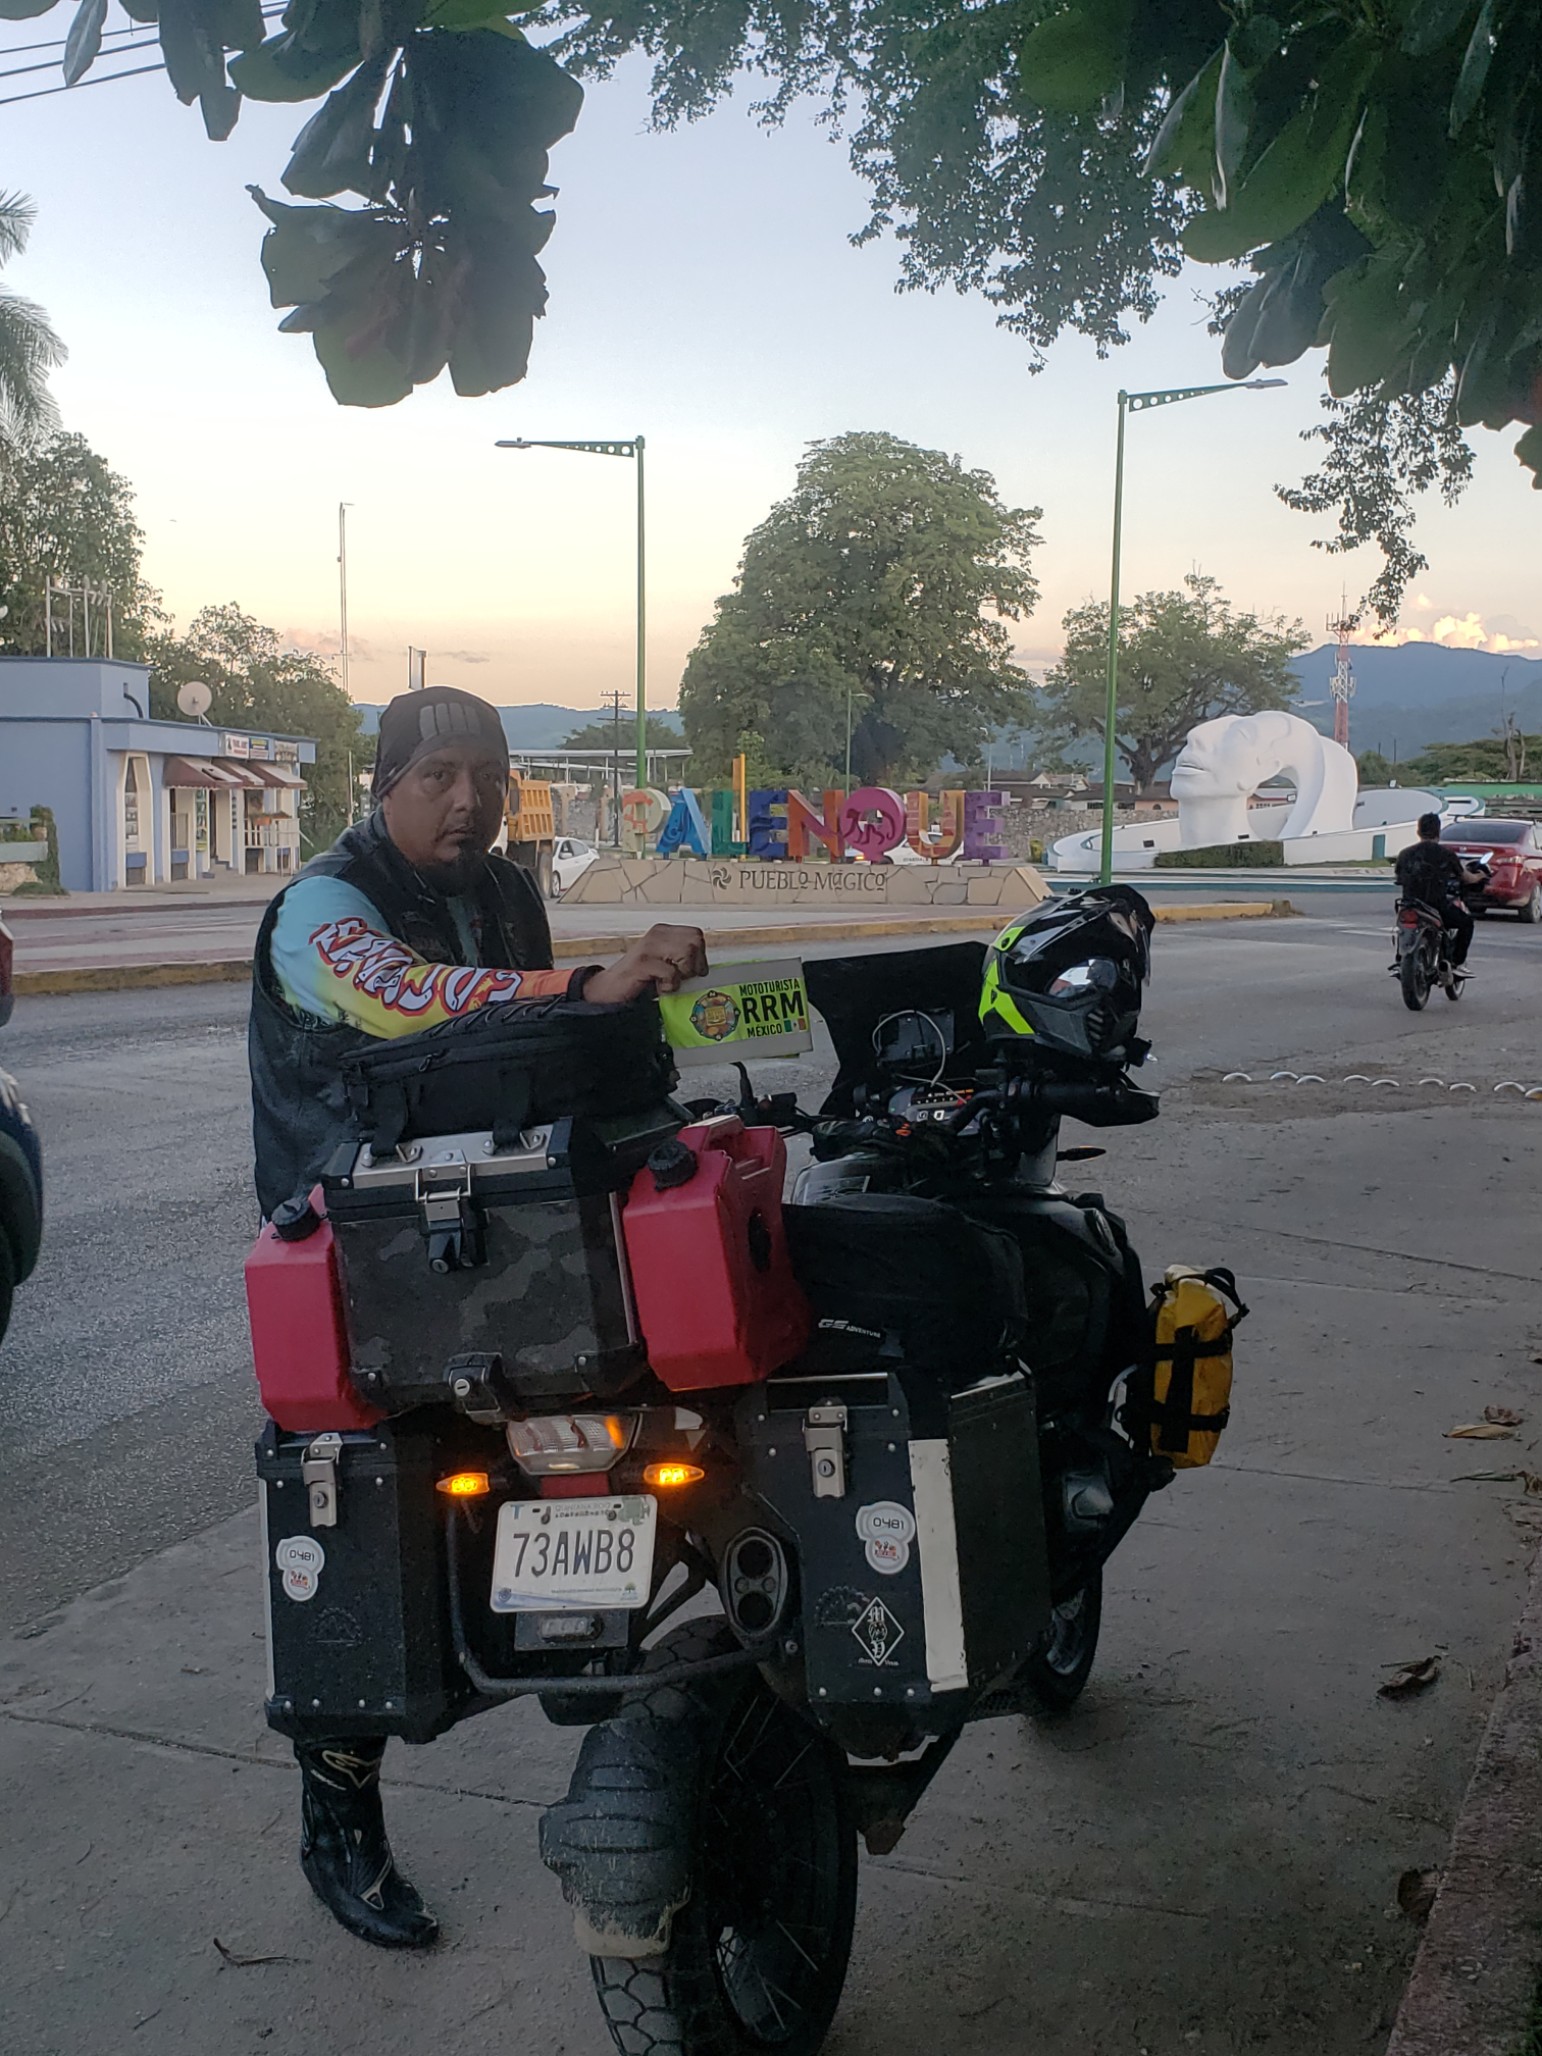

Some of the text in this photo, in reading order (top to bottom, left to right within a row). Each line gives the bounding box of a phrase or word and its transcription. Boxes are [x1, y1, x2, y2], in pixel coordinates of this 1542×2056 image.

[622, 787, 1010, 865] PALENQUE
[739, 870, 809, 890] PUEBLO
[739, 978, 800, 996] MOTOTURISTA
[741, 990, 805, 1024] RRM
[818, 1318, 881, 1339] GS ADVENTURE
[873, 1517, 905, 1530] 0481
[289, 1549, 315, 1562] 0481
[513, 1528, 635, 1578] 73AWB8
